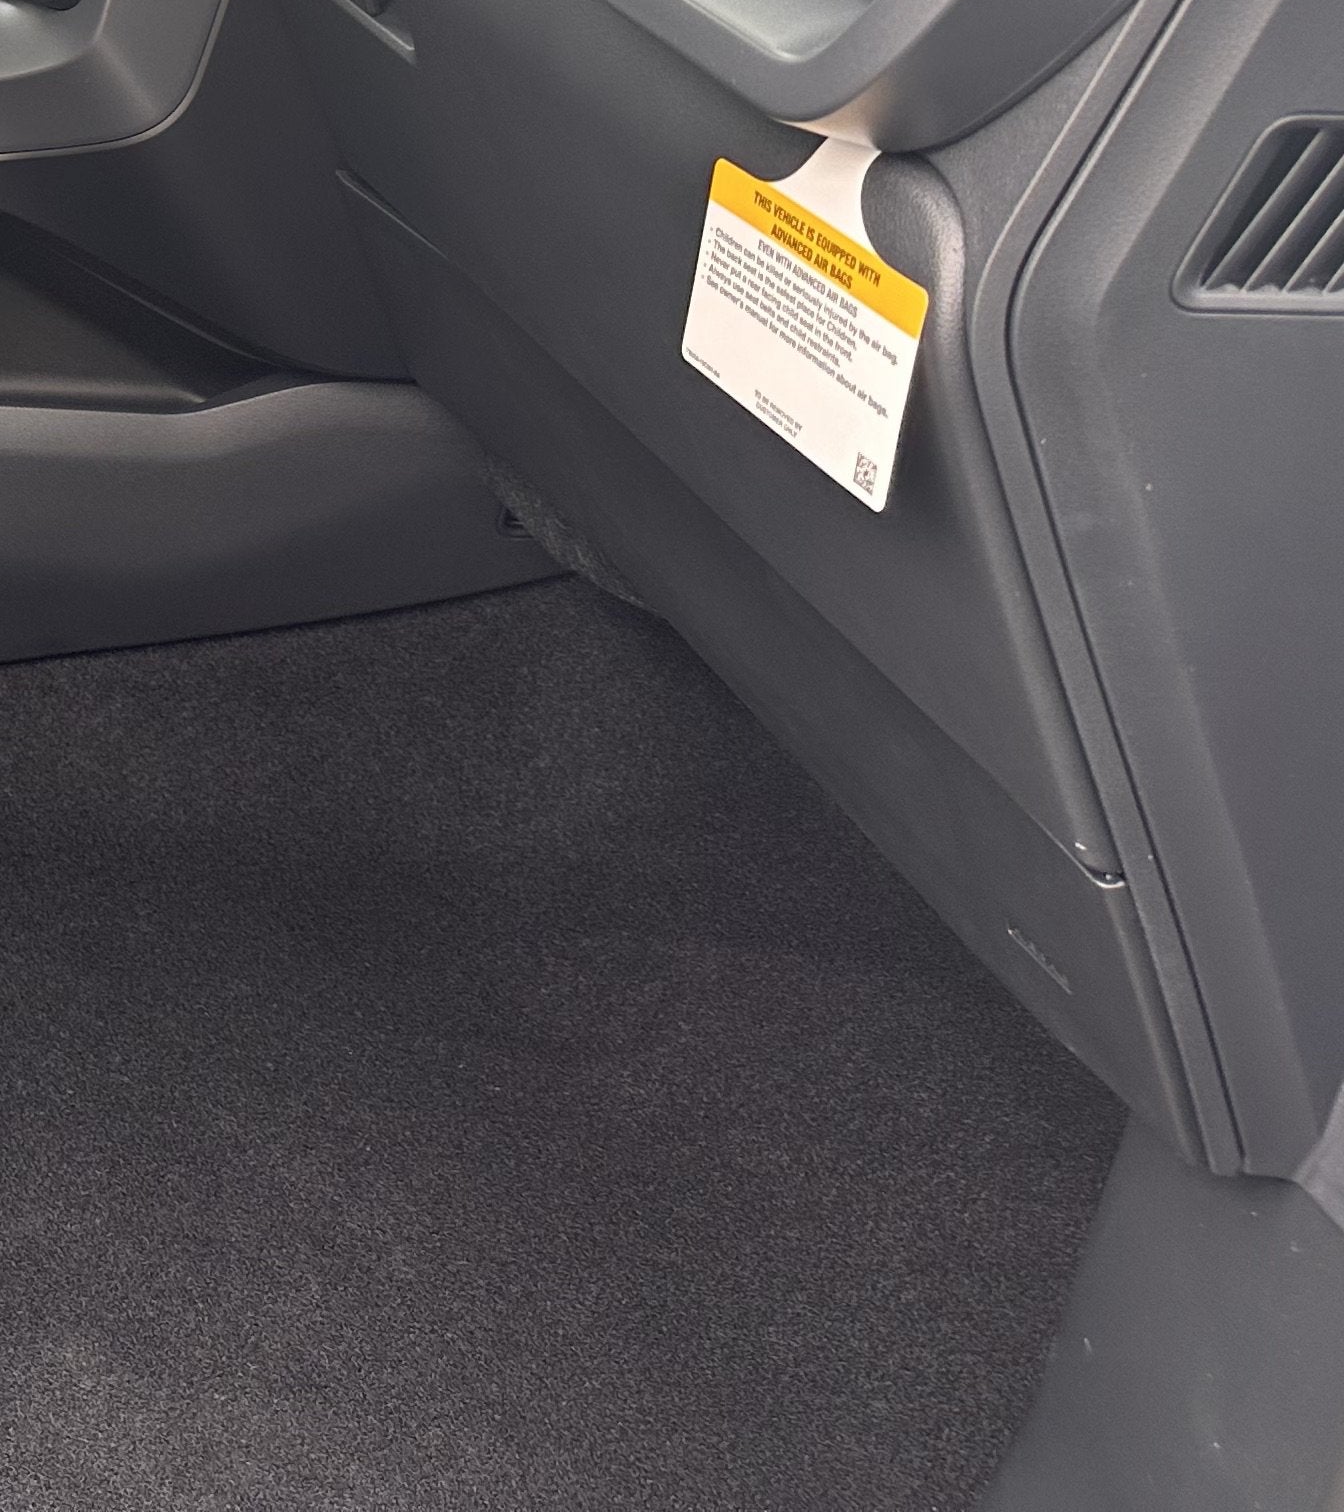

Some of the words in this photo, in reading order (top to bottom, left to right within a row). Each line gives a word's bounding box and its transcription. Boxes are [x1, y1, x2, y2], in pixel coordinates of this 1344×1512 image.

[713, 239, 725, 254] The
[726, 248, 742, 266] back
[742, 260, 756, 276] seat
[757, 270, 763, 281] is
[764, 275, 775, 290] the
[776, 284, 795, 304] safest
[796, 299, 814, 319] place
[816, 312, 825, 326] for
[753, 190, 772, 213] THIS
[773, 203, 805, 236] VEHICLE
[806, 225, 815, 242] IS
[816, 232, 856, 270] EQUIPPED
[857, 260, 880, 286] WITH
[757, 238, 774, 259] EVEN
[774, 250, 792, 272] WITH
[792, 262, 825, 295] ADVANCED
[826, 286, 838, 304] AIR
[839, 295, 858, 318] BAGS
[770, 222, 812, 262] ADVANCED
[813, 252, 828, 273] AIR
[829, 263, 852, 289] BAGS
[708, 263, 731, 287] Always
[732, 281, 744, 295] use
[745, 289, 758, 306] seat
[759, 300, 775, 318] belts
[776, 312, 789, 328] and
[789, 322, 806, 341] child
[710, 251, 729, 271] Never
[730, 265, 741, 281] put
[742, 275, 746, 283] a
[761, 287, 781, 310] facing
[782, 302, 798, 321] child
[799, 315, 813, 332] seat
[814, 326, 821, 337] in
[822, 331, 833, 346] the
[715, 227, 742, 253] Children
[743, 247, 755, 261] can
[756, 255, 764, 268] be
[765, 262, 783, 281] killed
[783, 276, 791, 287] or
[791, 281, 822, 312] seriously
[823, 303, 847, 329] injured
[848, 321, 857, 337] by
[858, 328, 870, 343] the
[871, 337, 881, 351] air
[706, 274, 718, 291] See
[744, 303, 768, 327] manual
[769, 321, 778, 335] for
[779, 329, 796, 348] more
[796, 341, 835, 377] information
[836, 370, 856, 393] about
[857, 386, 867, 401] air
